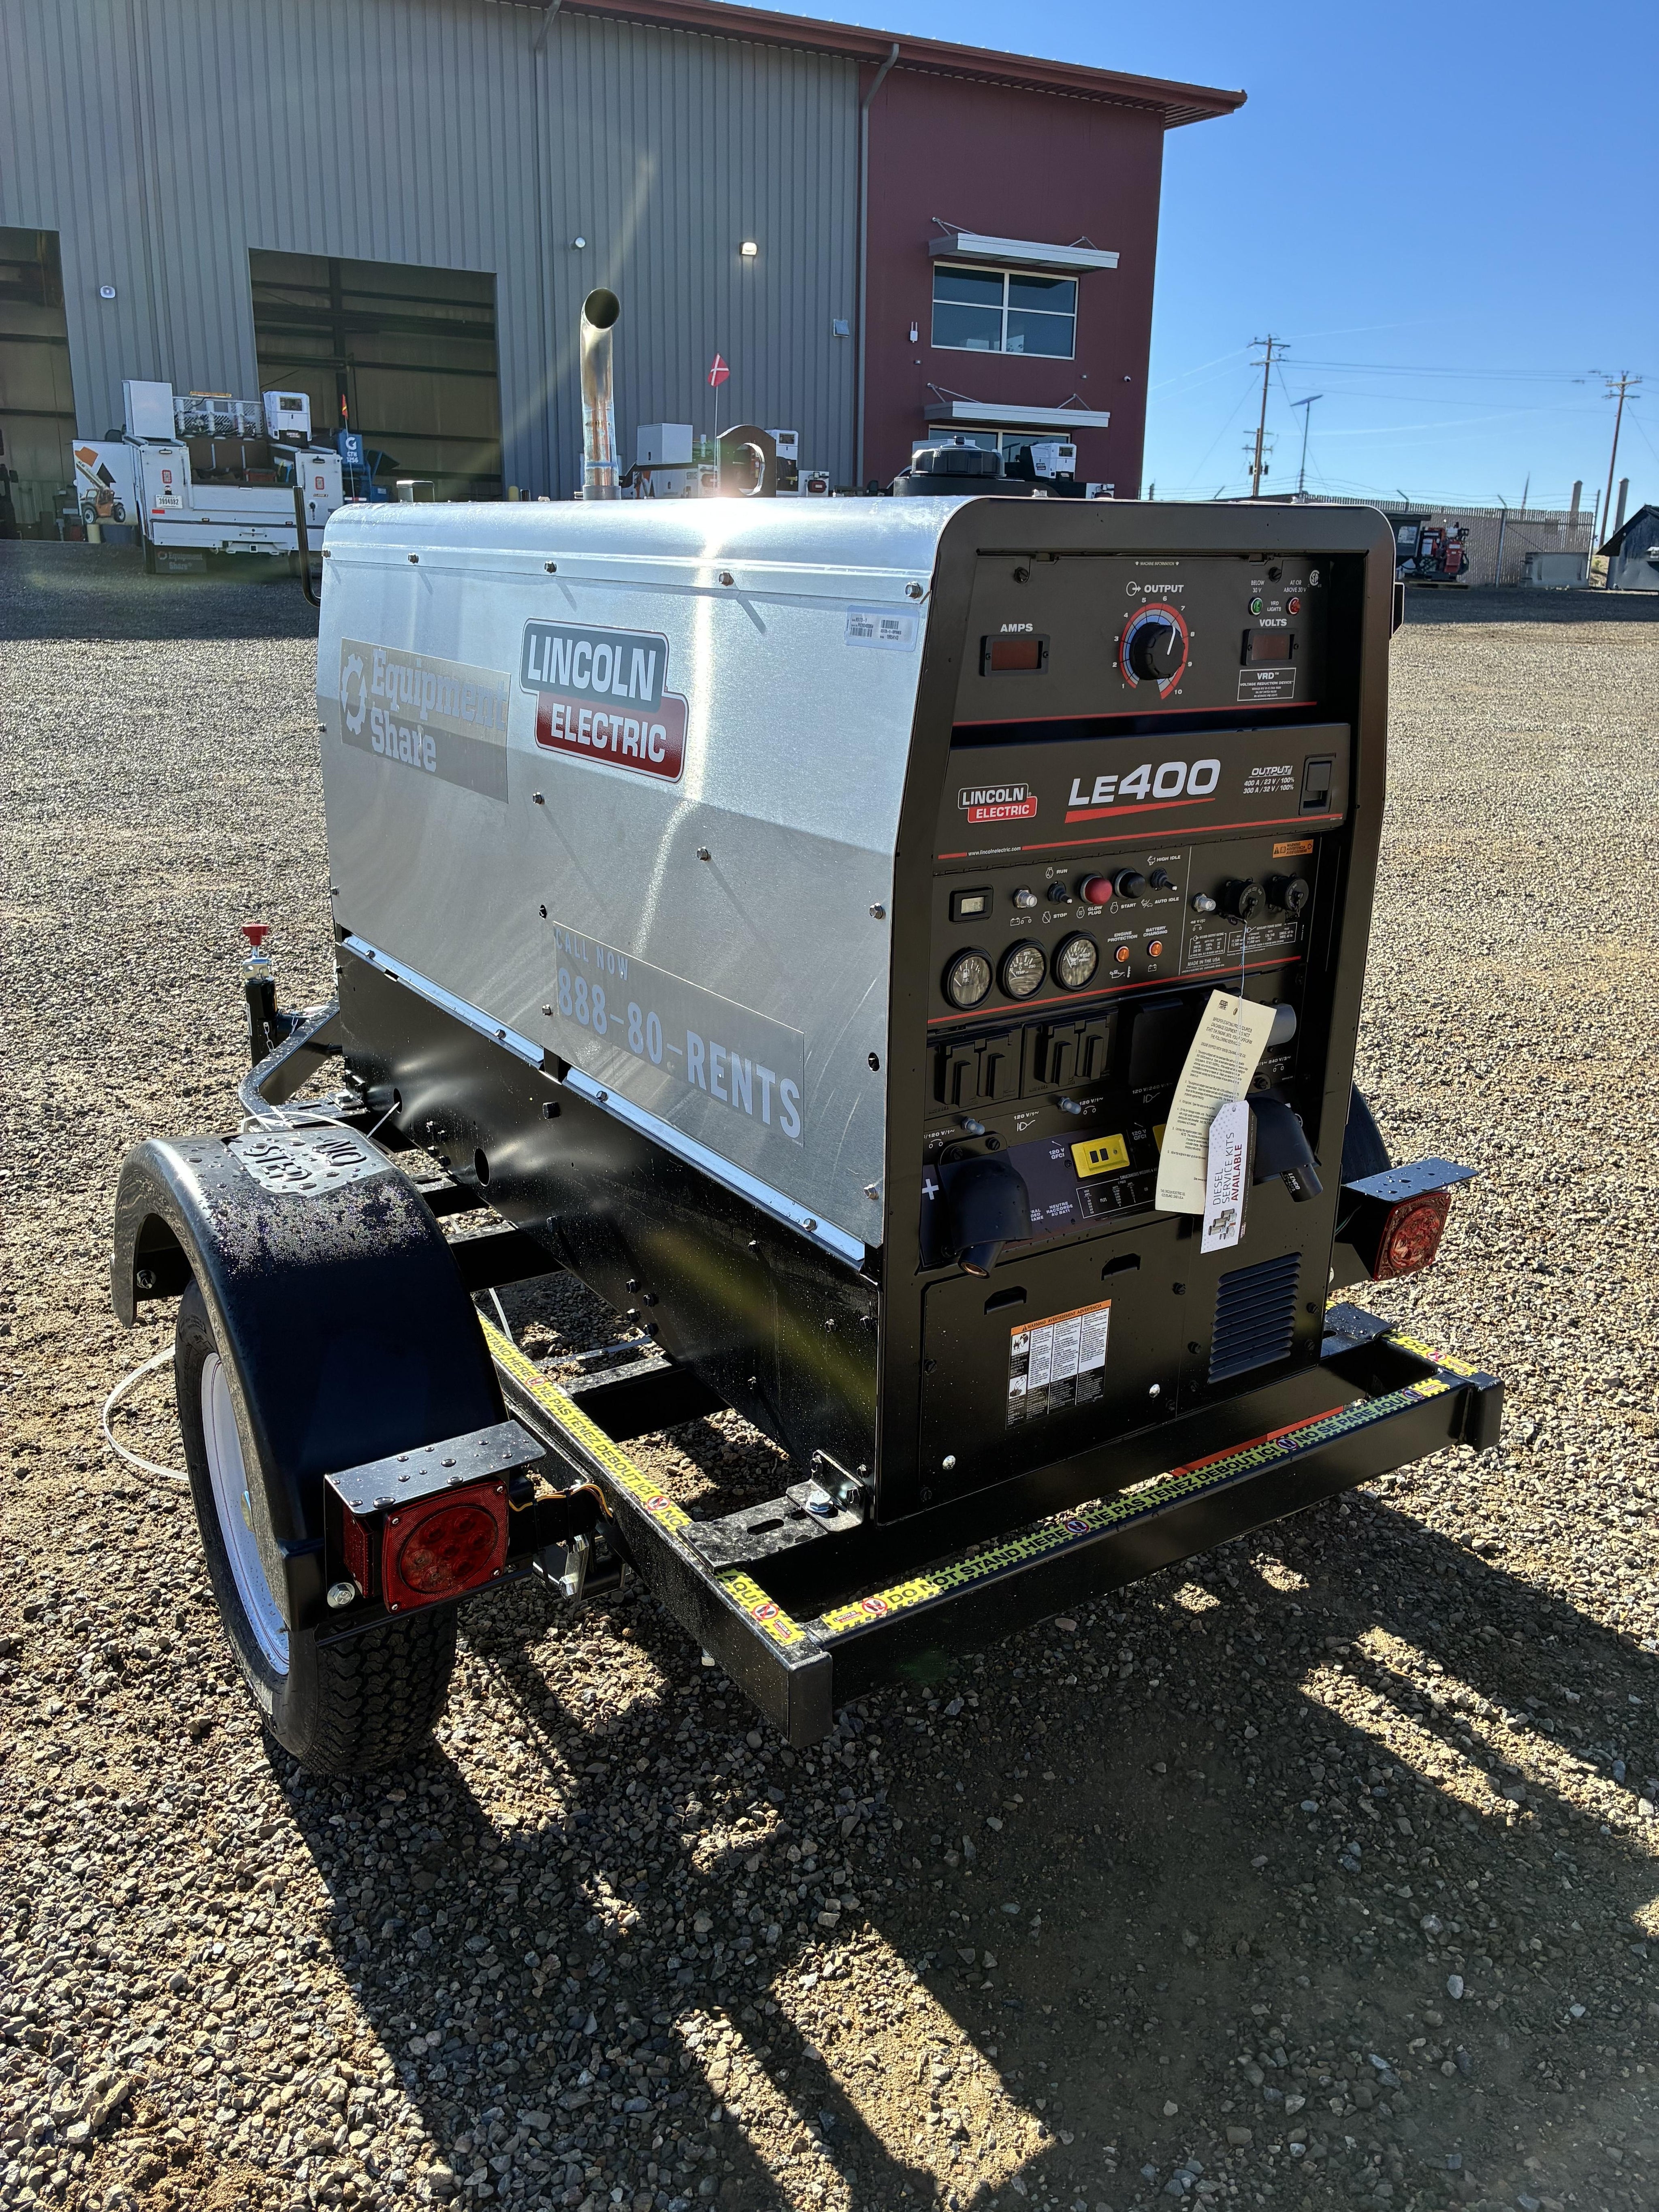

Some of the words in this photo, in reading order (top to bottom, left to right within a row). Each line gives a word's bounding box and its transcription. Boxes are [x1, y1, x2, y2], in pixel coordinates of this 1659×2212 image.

[1144, 584, 1184, 593] OUTPUT
[1000, 623, 1033, 632] AMPS
[1260, 619, 1287, 627] VOLTS
[527, 634, 657, 702] LINCOLN
[370, 649, 508, 732] Equipment
[370, 706, 437, 773] Share
[550, 702, 667, 763] ELECTRIC
[1068, 759, 1221, 806] LE400
[1251, 765, 1292, 776] OUTPUT
[962, 787, 1024, 805] LINCOLN
[976, 804, 1029, 819] ELECTRIC
[968, 847, 1021, 856] www.lincolnelectric.com
[1107, 934, 1138, 943] PROTECTION
[556, 928, 589, 963] CALL
[597, 947, 629, 981] NOW
[559, 967, 800, 1138] 888-80-RENTS
[312, 1139, 368, 1167] NO
[1226, 1132, 1234, 1156] KITS
[240, 1142, 312, 1182] STEP
[1231, 1144, 1242, 1201] AVAILABLE
[1213, 1169, 1223, 1205] DIESEL
[1222, 1160, 1233, 1204] SERVICE
[1288, 1173, 1301, 1190] LENCO
[1046, 1204, 1073, 1214] RACCORDE
[1048, 1312, 1076, 1323] AVERTISSEMENT
[1077, 1304, 1102, 1314] ADVERTENCIA
[486, 1332, 512, 1356] STAND
[506, 1357, 534, 1377] HERE
[1405, 1340, 1428, 1351] DO
[1295, 1431, 1319, 1442] NO
[1321, 1423, 1338, 1433] SE
[1337, 1408, 1375, 1426] PARE
[537, 1386, 556, 1398] NE
[549, 1398, 572, 1415] PAS
[567, 1415, 601, 1444] TENEZ
[595, 1444, 641, 1484] DEBOUT
[634, 1482, 655, 1495] ICI
[1087, 1510, 1114, 1526] NE
[1115, 1499, 1147, 1515] PAS
[1147, 1477, 1198, 1502] TENEZ
[1196, 1454, 1257, 1482] DEBOUT
[1256, 1446, 1280, 1458] ICI
[661, 1510, 683, 1526] NO
[887, 1589, 918, 1603] DO
[918, 1570, 957, 1591] NOT
[960, 1548, 1021, 1575] STAND
[1021, 1527, 1070, 1552] HERE
[776, 1619, 791, 1635] LINCOLN
[834, 1611, 857, 1621] LINCOLN
